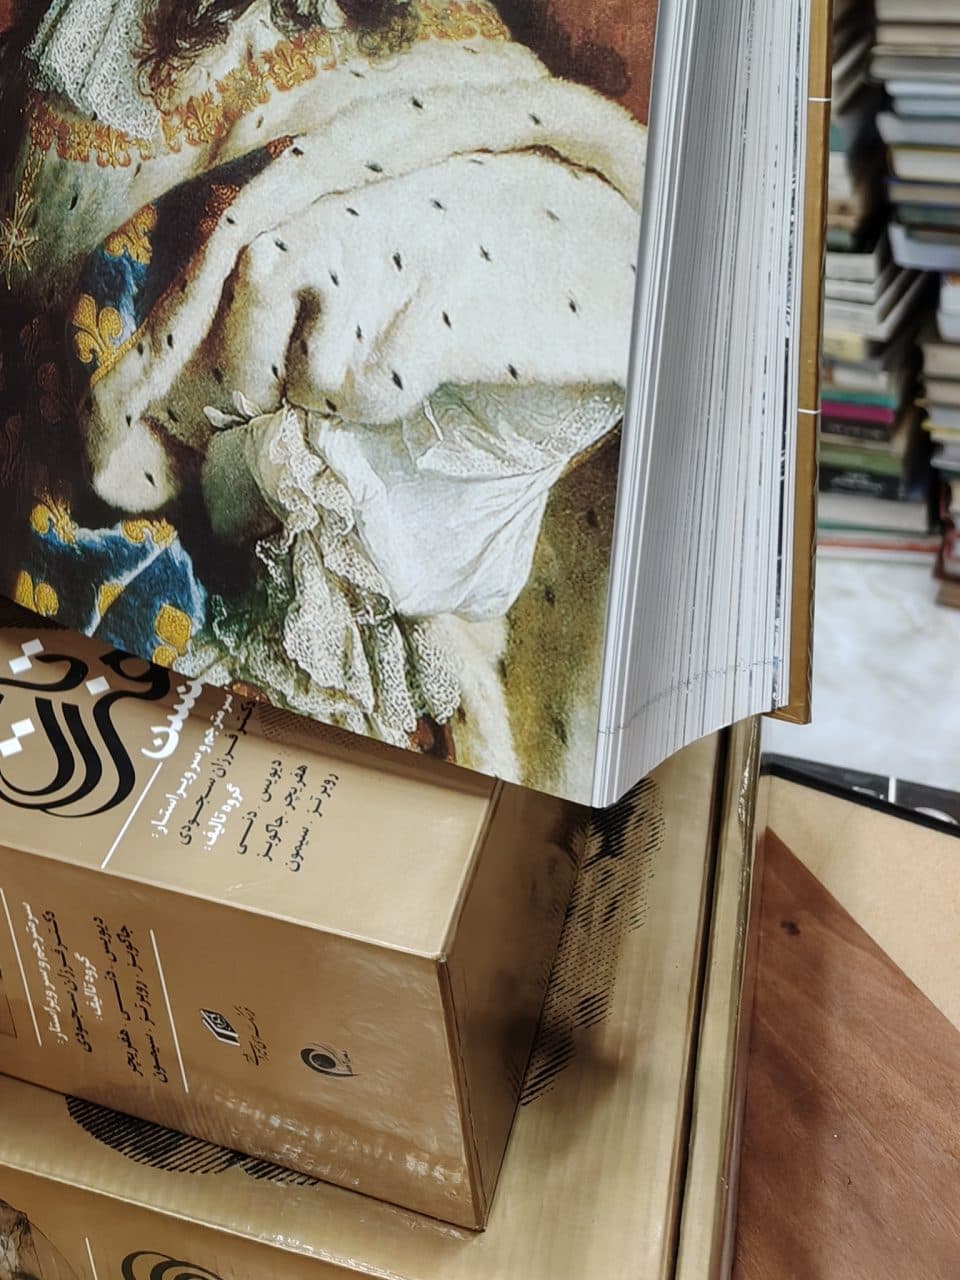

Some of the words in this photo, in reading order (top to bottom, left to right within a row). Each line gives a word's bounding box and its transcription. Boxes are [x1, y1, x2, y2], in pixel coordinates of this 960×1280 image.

[140, 680, 204, 759] نسن
[211, 733, 239, 779] فرزان
[224, 782, 243, 813] گروه
[262, 760, 282, 803] دیویس
[285, 764, 308, 810] هفریچر
[308, 773, 339, 817] روبرتز
[179, 777, 216, 846] سجودی
[237, 810, 257, 855] دنی
[257, 816, 288, 861] جاکوبز
[285, 826, 309, 872] سیمون
